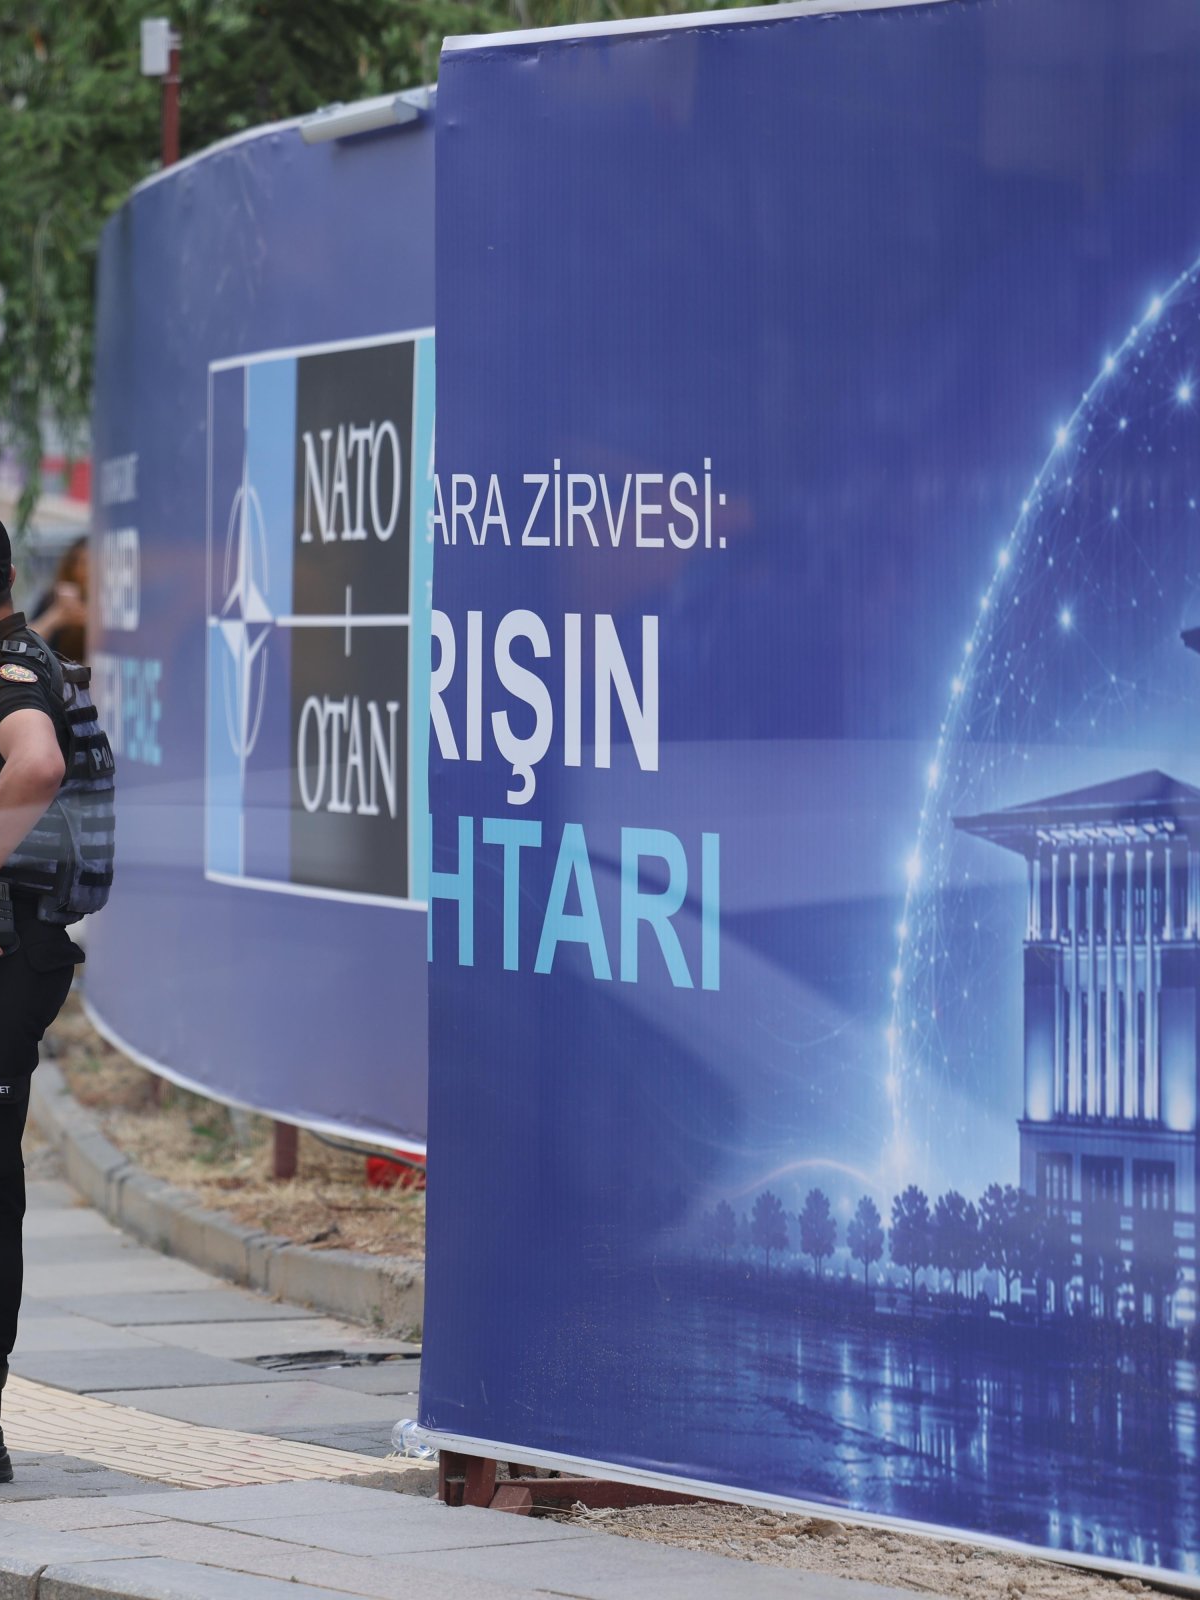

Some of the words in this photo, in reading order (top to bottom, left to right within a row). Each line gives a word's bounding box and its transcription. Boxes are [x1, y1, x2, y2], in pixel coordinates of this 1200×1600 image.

[301, 420, 401, 543] NATO
[521, 457, 727, 550] ZİRVESİ:
[298, 695, 399, 819] OTAN
[427, 813, 721, 992] HTARI
